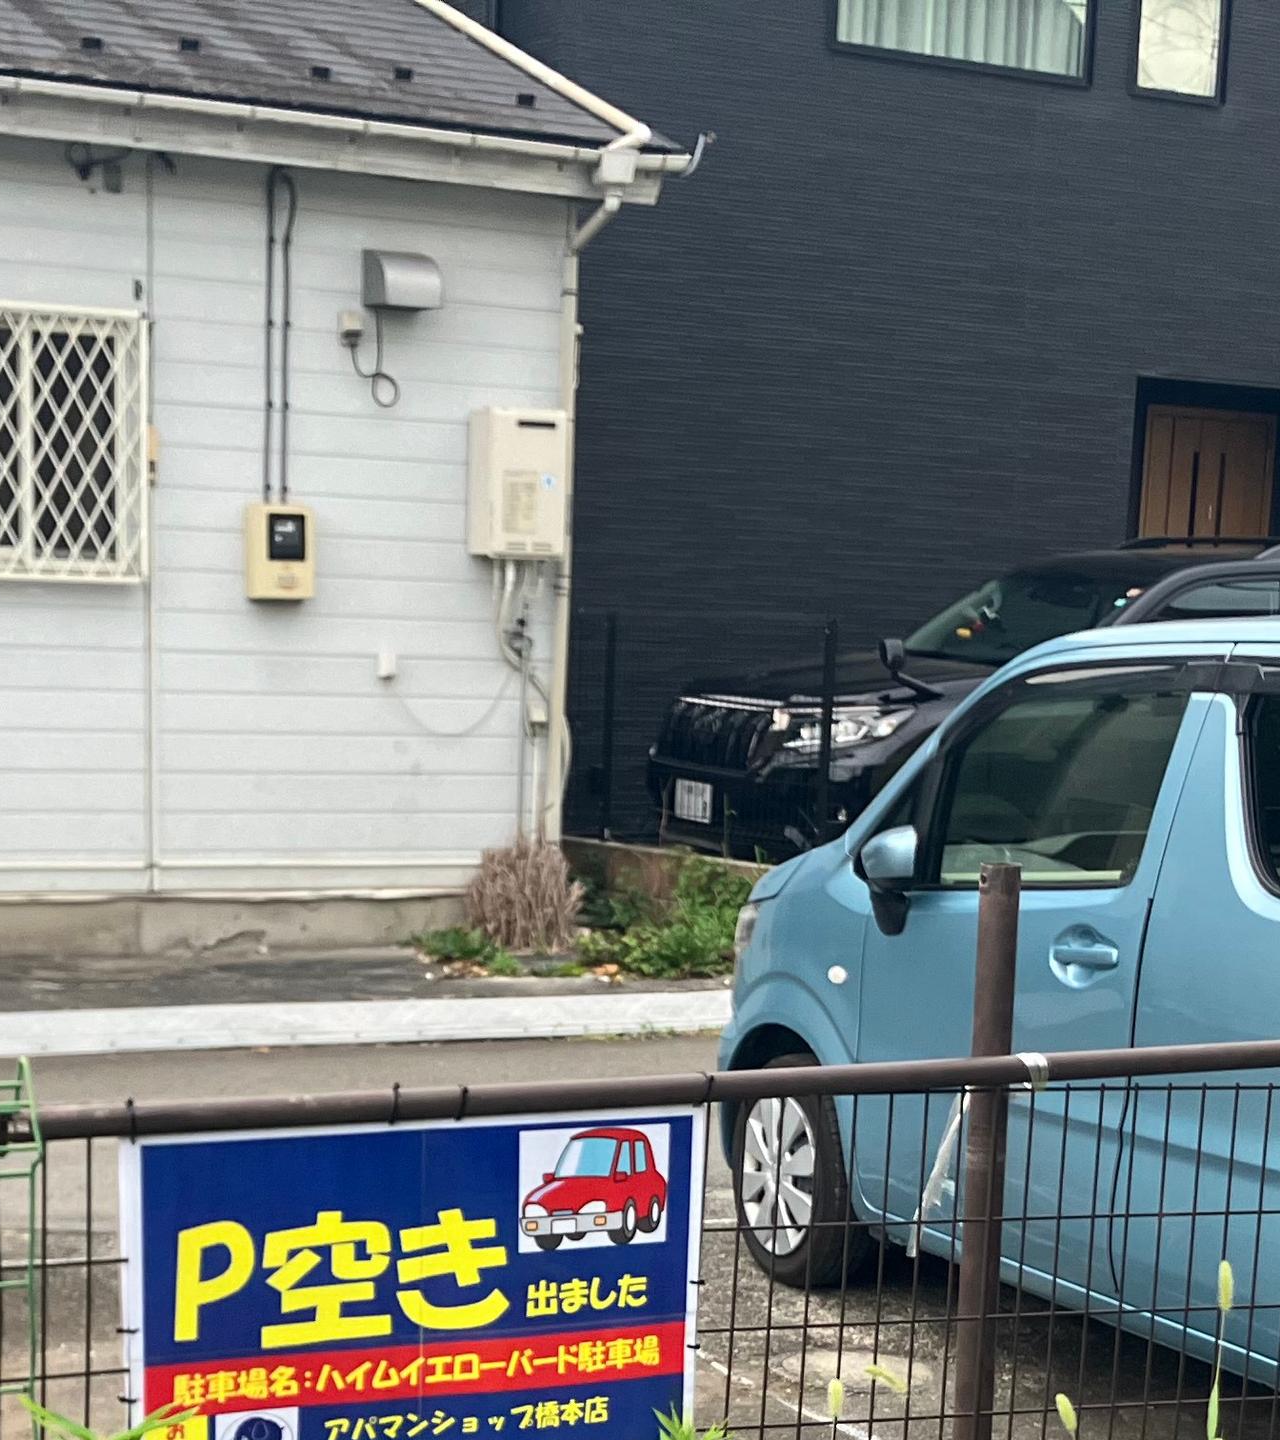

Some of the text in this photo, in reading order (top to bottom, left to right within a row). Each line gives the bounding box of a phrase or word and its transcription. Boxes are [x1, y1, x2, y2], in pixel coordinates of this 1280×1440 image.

[173, 1207, 648, 1349] P空き 出ました
